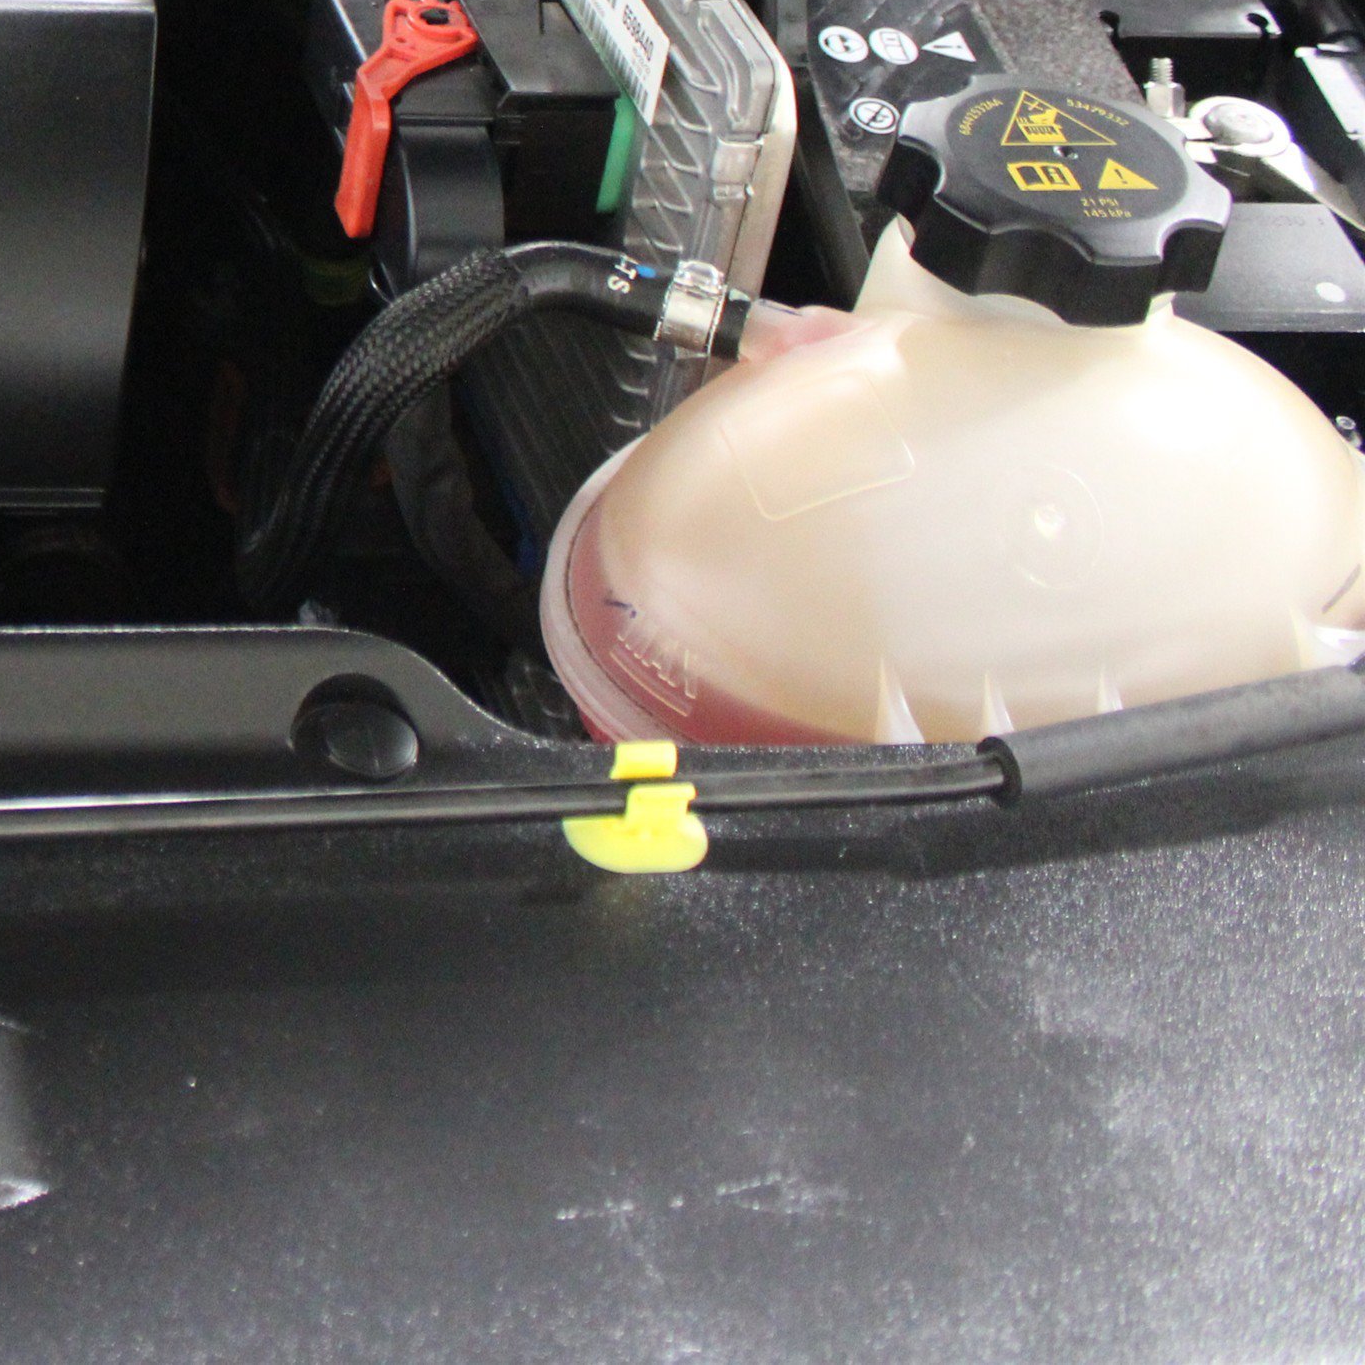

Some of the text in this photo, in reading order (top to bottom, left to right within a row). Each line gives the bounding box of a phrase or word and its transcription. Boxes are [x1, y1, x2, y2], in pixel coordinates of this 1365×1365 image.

[1080, 197, 1119, 207] 21 PSI
[1108, 208, 1133, 218] kPa
